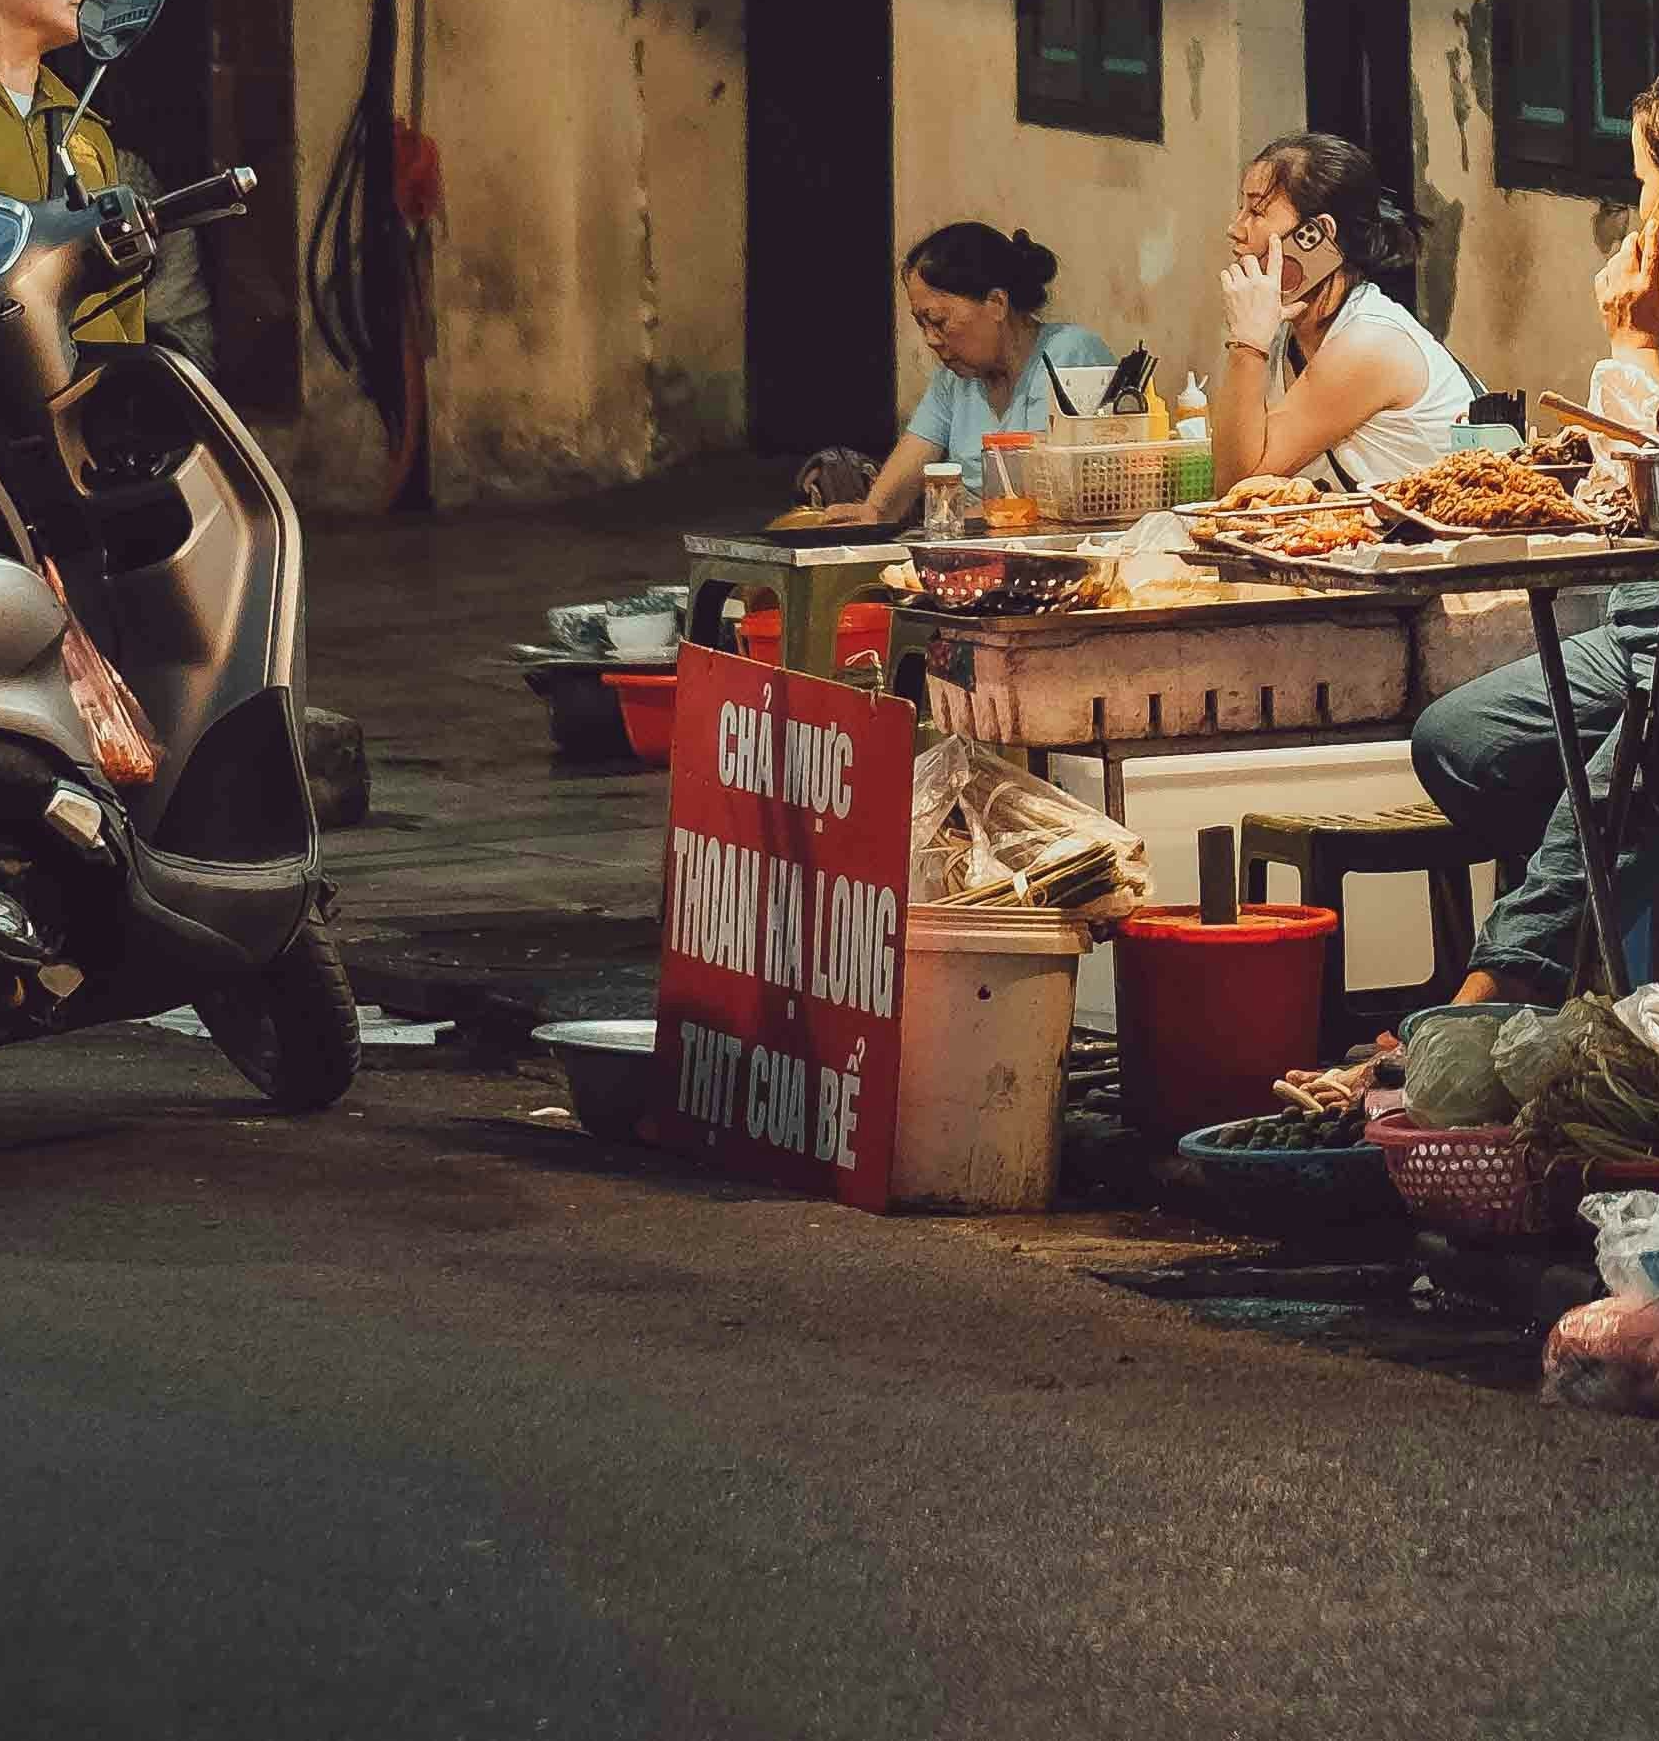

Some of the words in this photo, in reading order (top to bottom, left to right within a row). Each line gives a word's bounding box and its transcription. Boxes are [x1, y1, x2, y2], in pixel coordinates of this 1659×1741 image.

[718, 683, 773, 798] CHẢ
[784, 716, 854, 833] MỰC
[670, 827, 760, 976] THOAN
[765, 854, 804, 1019] HẠ
[812, 868, 897, 1018] LONG
[677, 1020, 742, 1146] THỊT
[746, 1044, 806, 1155] CUA
[815, 1036, 866, 1171] BỂ
